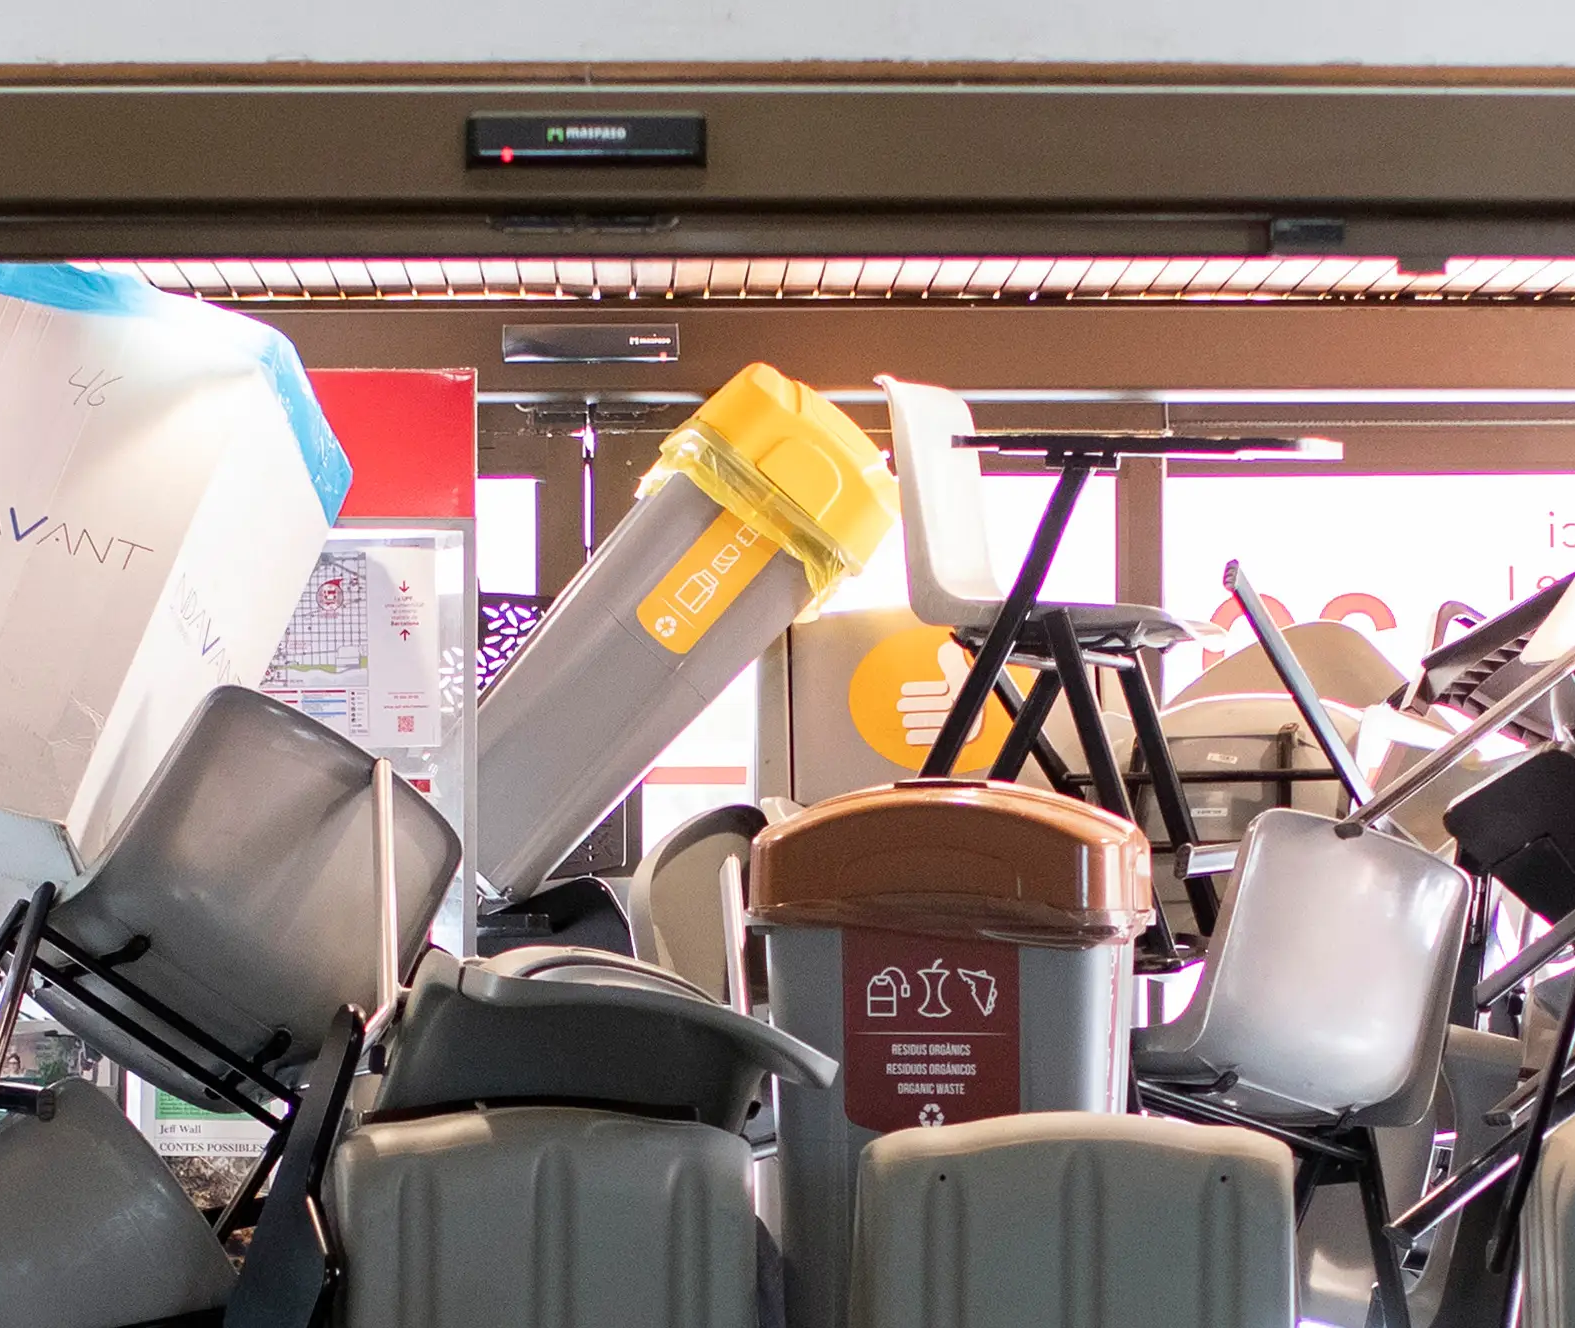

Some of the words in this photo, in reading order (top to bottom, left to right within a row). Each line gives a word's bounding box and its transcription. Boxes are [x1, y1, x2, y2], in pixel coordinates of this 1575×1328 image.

[68, 365, 124, 406] 46
[891, 1043, 927, 1056] RESIDUS
[886, 1063, 927, 1075] RESIDUOS
[897, 1083, 934, 1095] ORGANIC
[936, 1083, 966, 1095] WASTE
[159, 1124, 176, 1135] Jeff
[180, 1124, 202, 1134] Wall
[159, 1142, 205, 1152] CONTES
[206, 1142, 264, 1152] POSSIBLES
